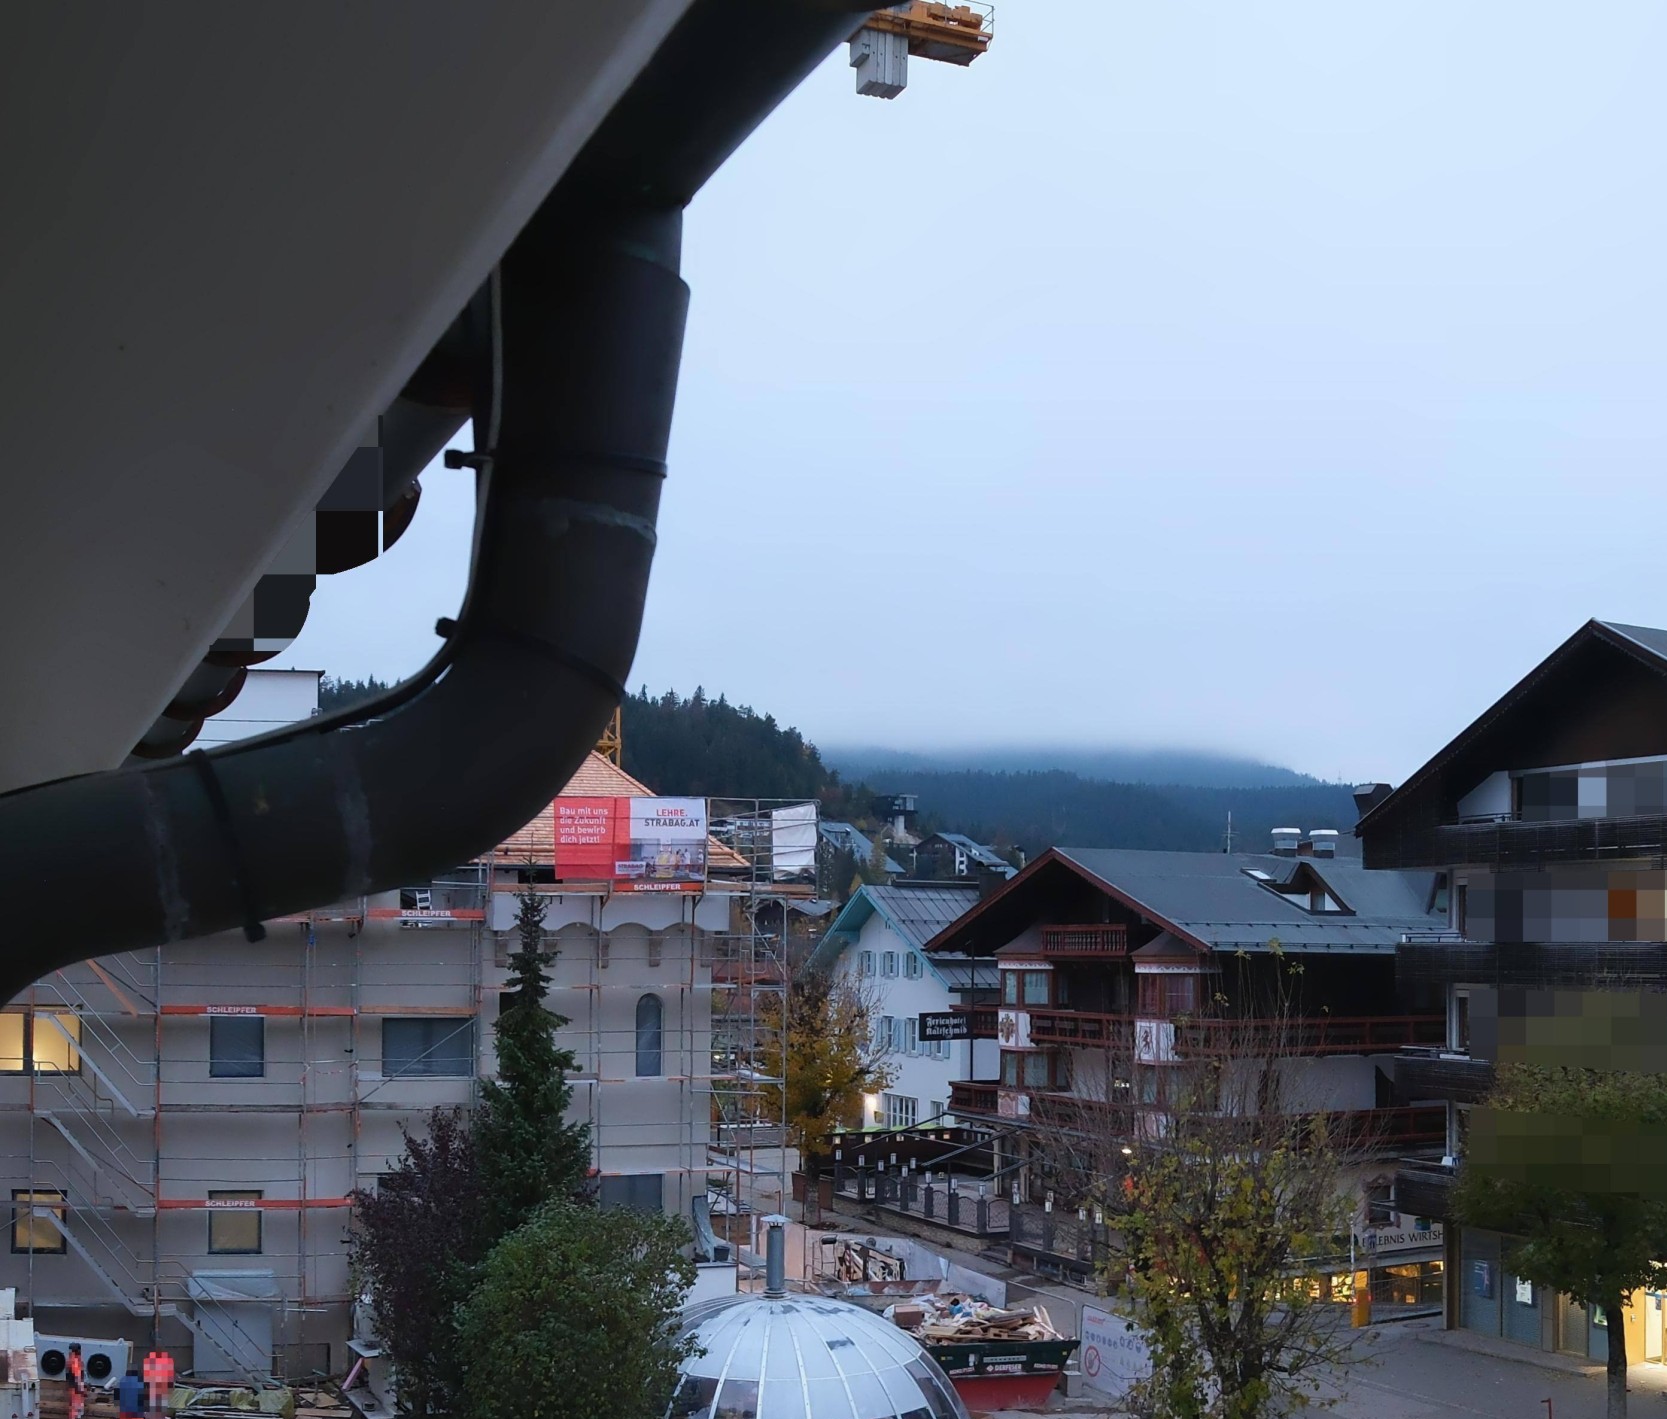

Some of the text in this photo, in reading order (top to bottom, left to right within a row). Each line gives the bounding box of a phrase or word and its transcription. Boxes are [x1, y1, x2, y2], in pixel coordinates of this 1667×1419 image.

[559, 806, 576, 815] Bau
[578, 807, 591, 815] mit
[656, 808, 688, 817] LEHRE.
[560, 816, 573, 824] die
[644, 818, 700, 828] STRABAG.AT
[560, 826, 606, 834] und bewirb
[560, 835, 600, 845] dich jetzt!
[633, 883, 681, 891] SCHLEIPFER
[401, 909, 451, 918] SCHLEIPFER
[206, 1006, 257, 1014] SCHLEIPFER
[205, 1199, 255, 1208] SCHLEIPFER
